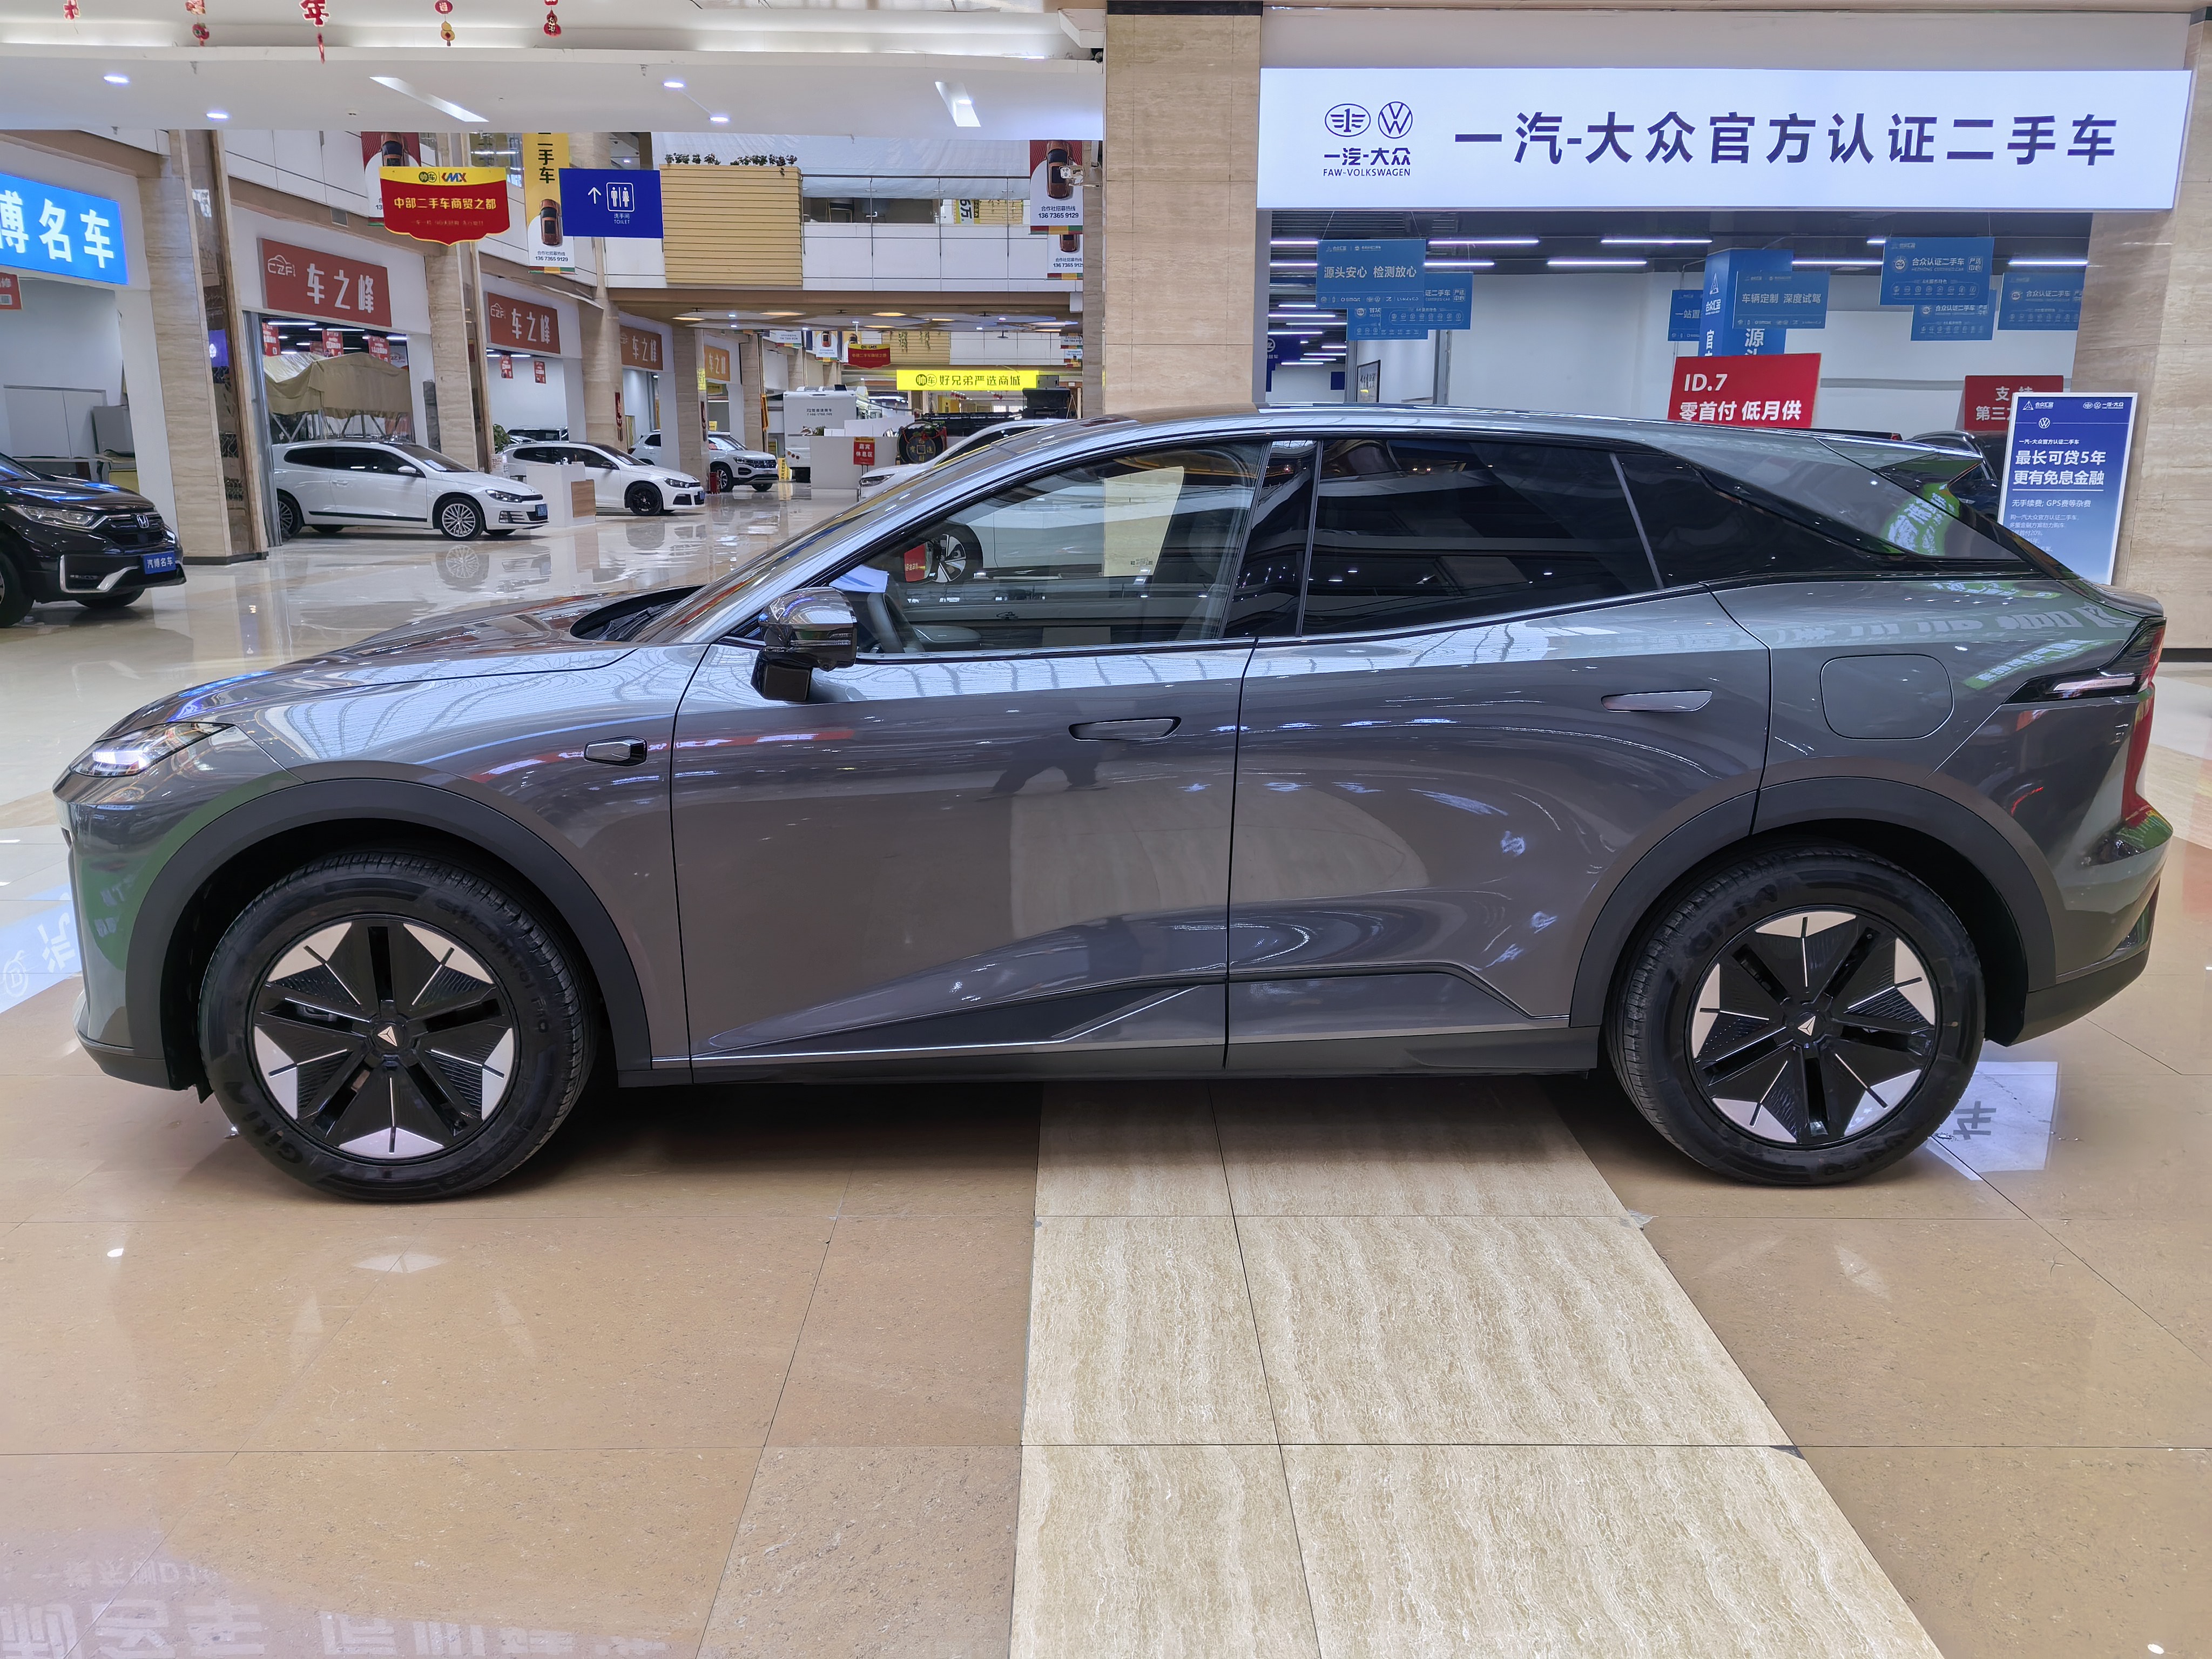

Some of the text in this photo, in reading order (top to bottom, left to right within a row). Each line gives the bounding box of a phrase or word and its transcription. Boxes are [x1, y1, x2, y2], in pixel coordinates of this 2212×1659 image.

[1455, 111, 2117, 166] 一汽-大众官方认证二手车
[1324, 147, 1411, 165] 一汽-大众
[1323, 168, 1411, 177] FAW-VOLKSWAGEN
[394, 197, 496, 210] 中部二手车商贸之都
[1912, 258, 1965, 266] 合众认证二手车
[1324, 266, 1417, 278] 源头安心 检测放心
[307, 263, 374, 313] 车之峰
[1742, 293, 1822, 304] 车辆定制 深度试驾
[511, 308, 550, 344] 车之峰
[1705, 329, 1715, 356] 官
[940, 375, 1021, 386] 好兄弟严选商城
[1684, 374, 1728, 392] ID.7
[1679, 400, 1802, 421] 零首付 低月供
[1975, 406, 2011, 421] 第三
[2015, 450, 2106, 466] 最长可贷5年
[2013, 470, 2105, 485] 更有免息金融
[147, 556, 173, 569] 汽博名车
